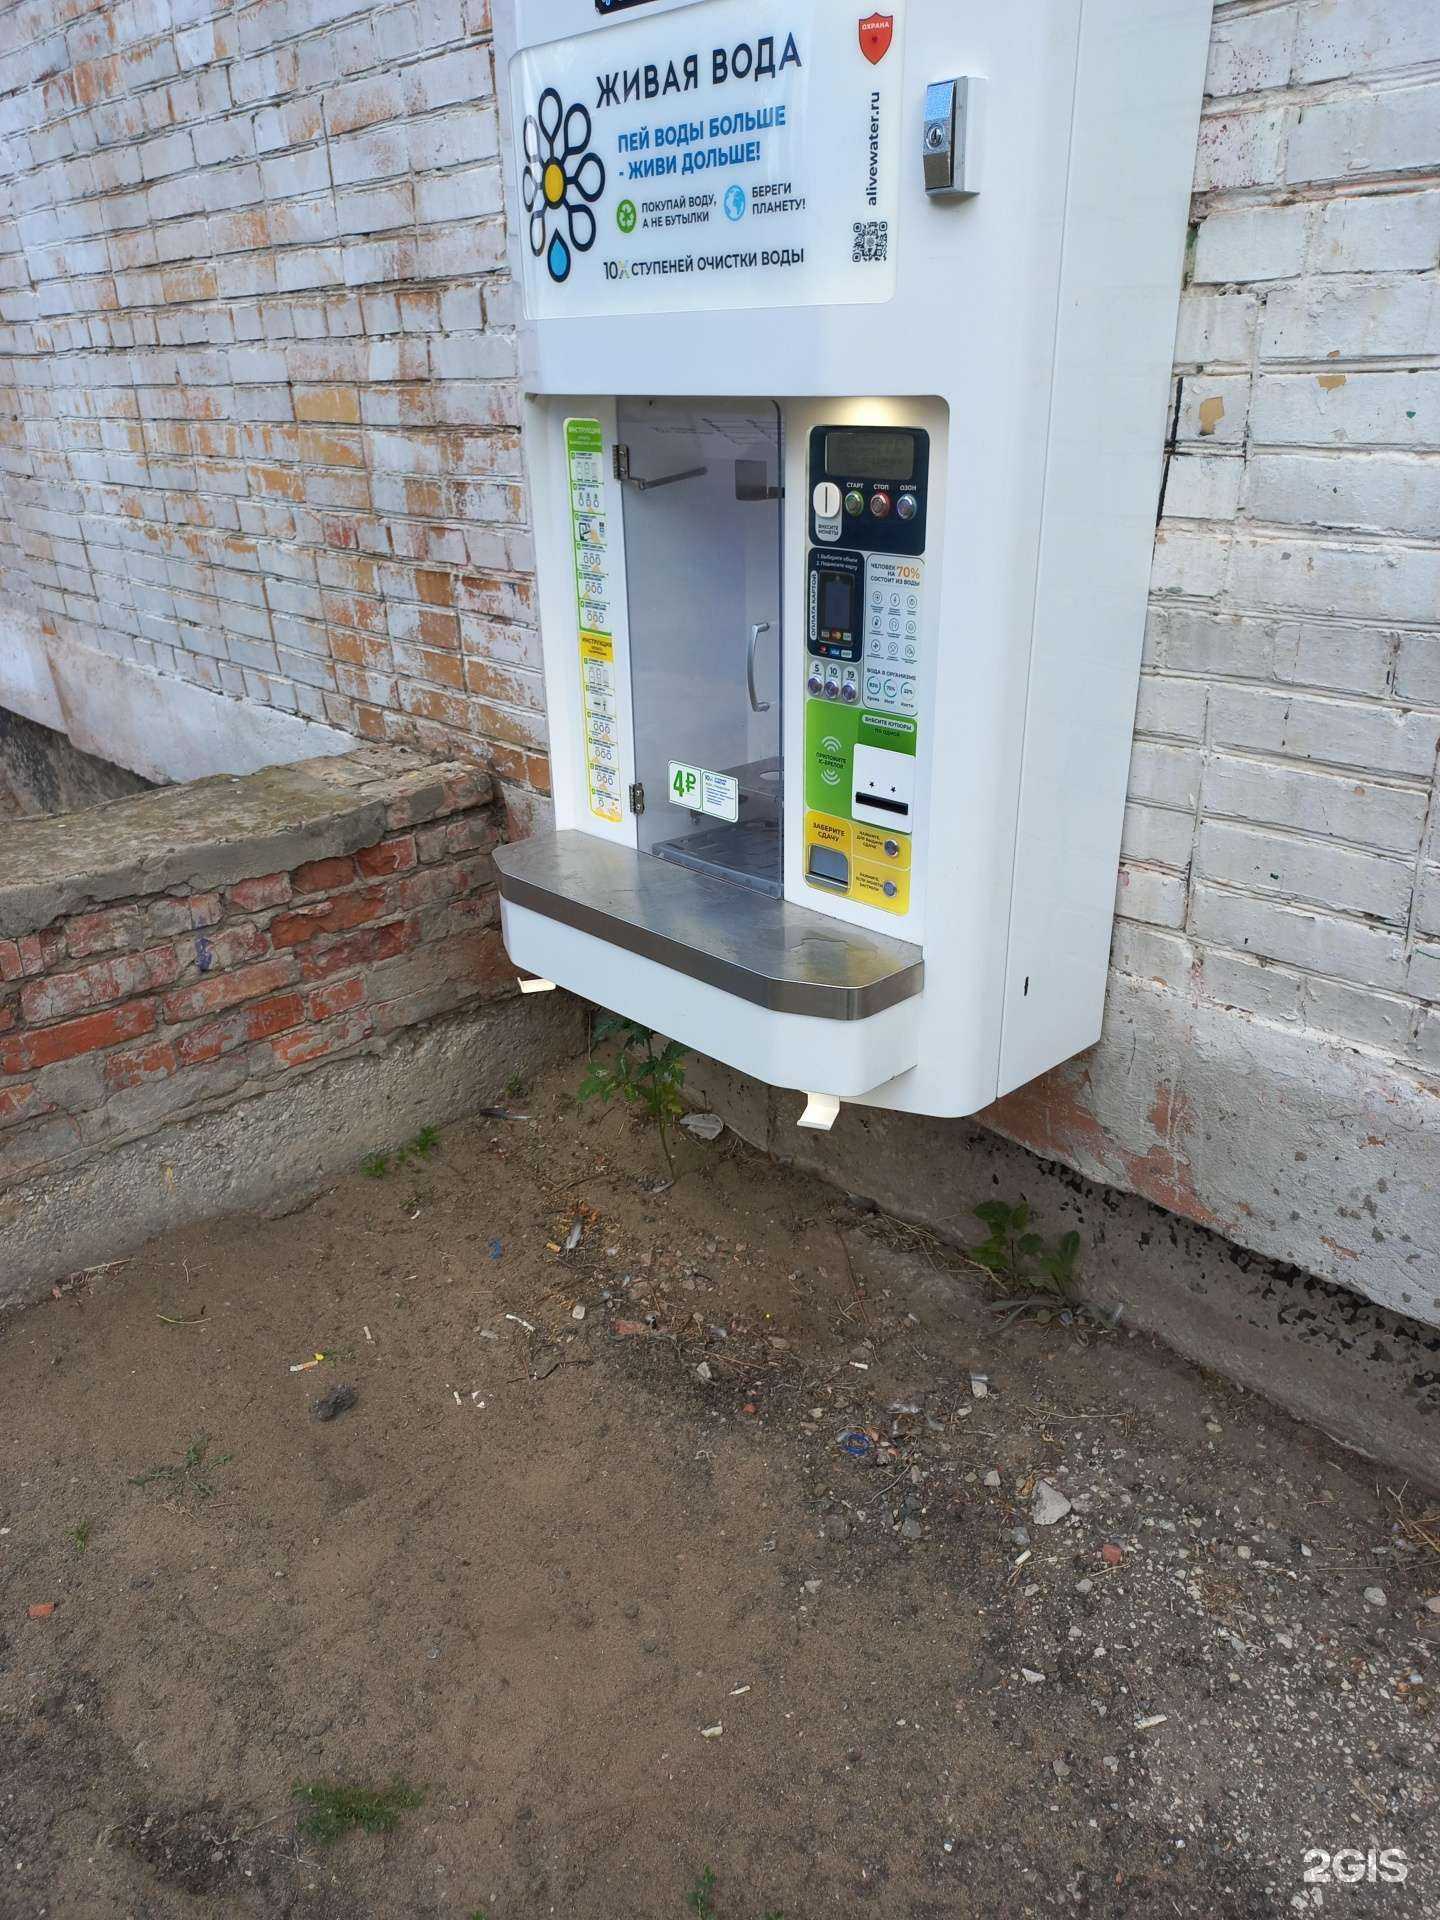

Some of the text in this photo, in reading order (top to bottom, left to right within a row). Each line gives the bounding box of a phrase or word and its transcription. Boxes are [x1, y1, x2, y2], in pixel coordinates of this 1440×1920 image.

[862, 22, 890, 30] ОХРАНА
[596, 31, 802, 108] ЖИВАЯ ВОДА
[618, 105, 786, 153] ПЕЙ ВОДЫ БОЛЬШЕ
[866, 92, 880, 206] alivewater.ru
[628, 158, 677, 179] ЖИВИ
[681, 141, 761, 176] ДОЛЬШЕ!
[752, 183, 791, 198] БЕРЕГИ
[641, 193, 717, 213] ПОКУПАЙ ВОДУ,
[752, 198, 806, 215] ПЛАНЕТУ!
[642, 212, 709, 228] А НЕ БУТЫЛКИ
[631, 254, 693, 276] СТУПЕНЕЙ
[697, 253, 757, 270] ОЧИСТКИ
[762, 248, 804, 266] ВОДЫ
[896, 566, 920, 579] 70%
[814, 664, 820, 672] 5
[829, 667, 837, 675] 10
[847, 670, 854, 678] 19
[813, 822, 845, 837] ЗАБЕРИТЕ
[818, 832, 840, 842] СДАЧУ
